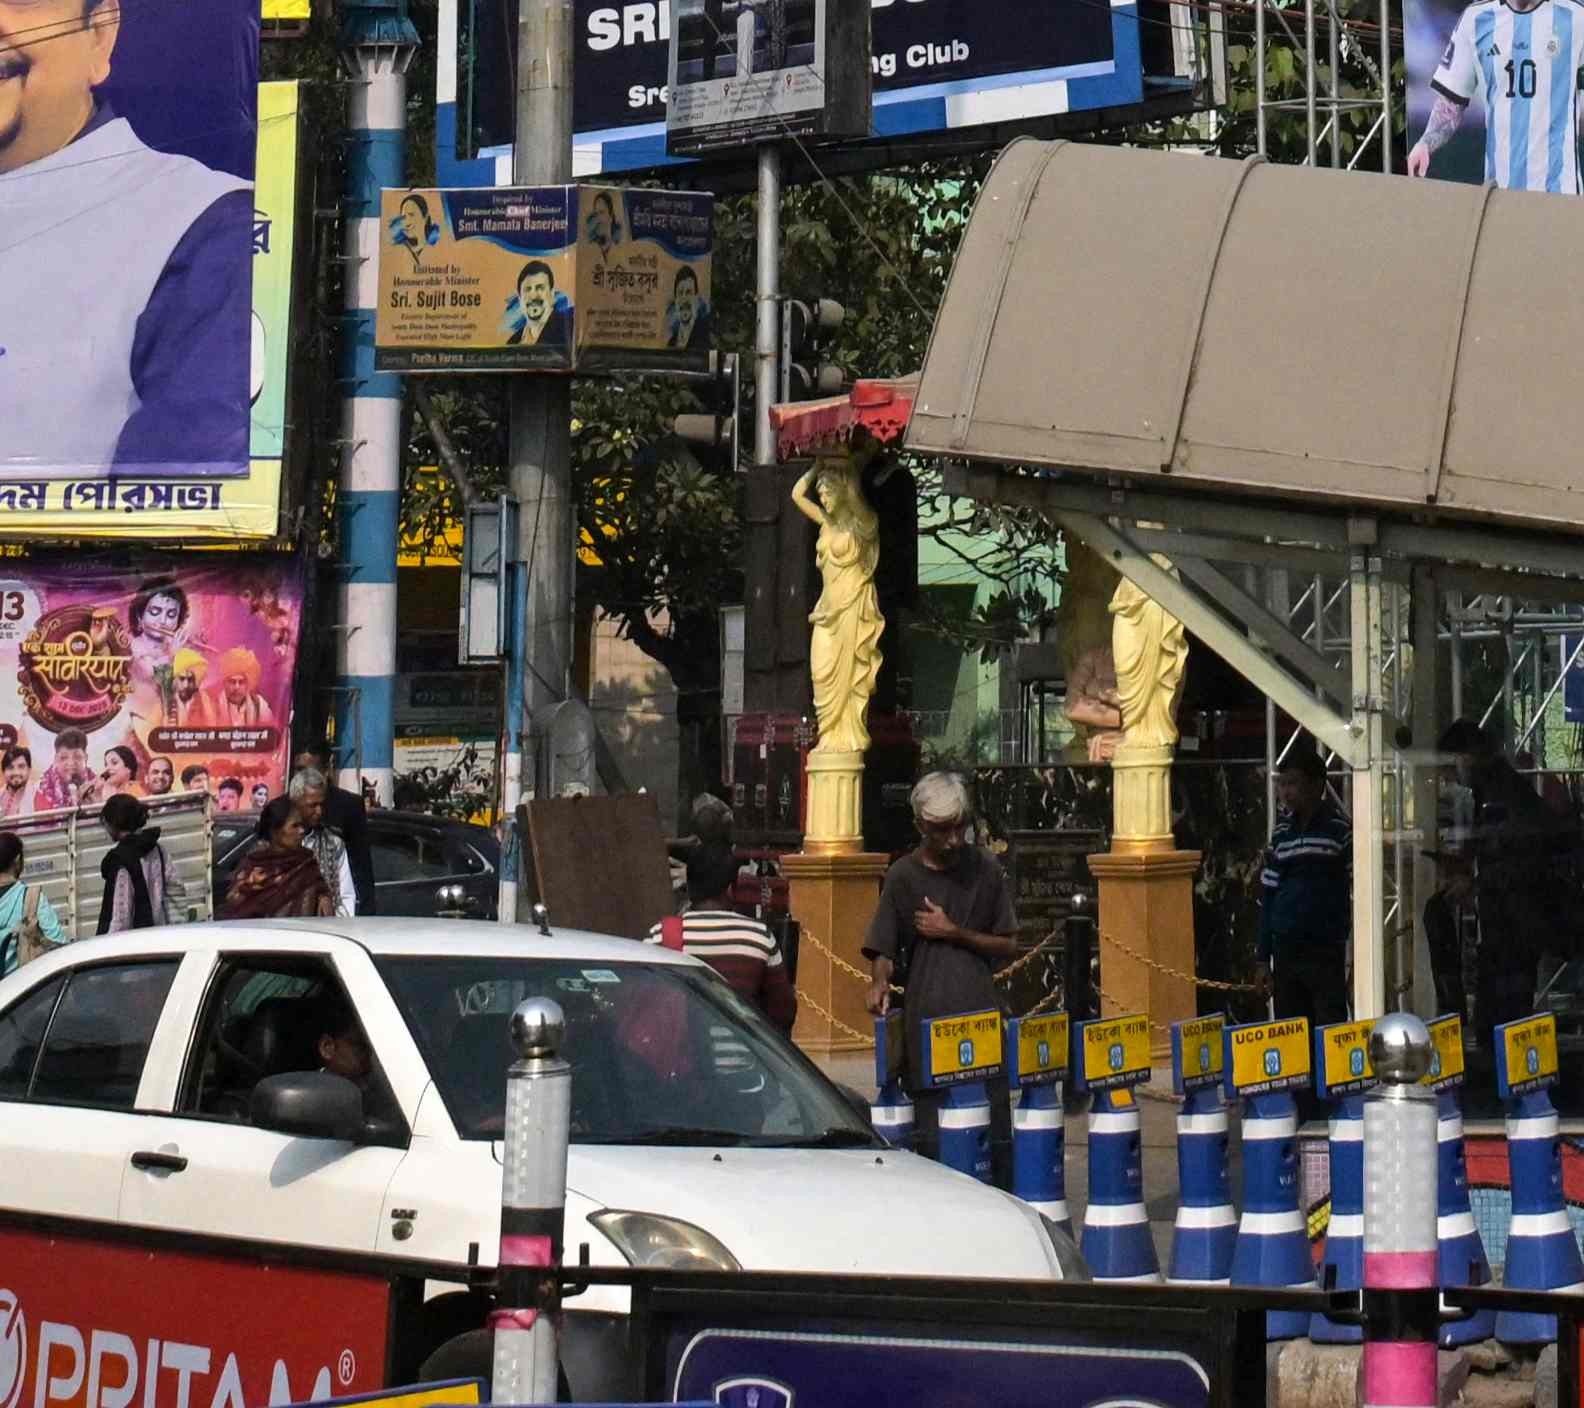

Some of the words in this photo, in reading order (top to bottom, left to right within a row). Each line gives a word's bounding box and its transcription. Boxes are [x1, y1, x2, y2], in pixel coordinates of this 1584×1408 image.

[906, 39, 970, 68] Club
[1504, 59, 1537, 99] 10
[483, 219, 521, 232] Mamata
[391, 291, 412, 308] Sri.
[417, 291, 446, 311] Sujit
[450, 291, 481, 307] Bose
[1235, 1028, 1263, 1045] UCO
[1266, 1023, 1305, 1040] BANK
